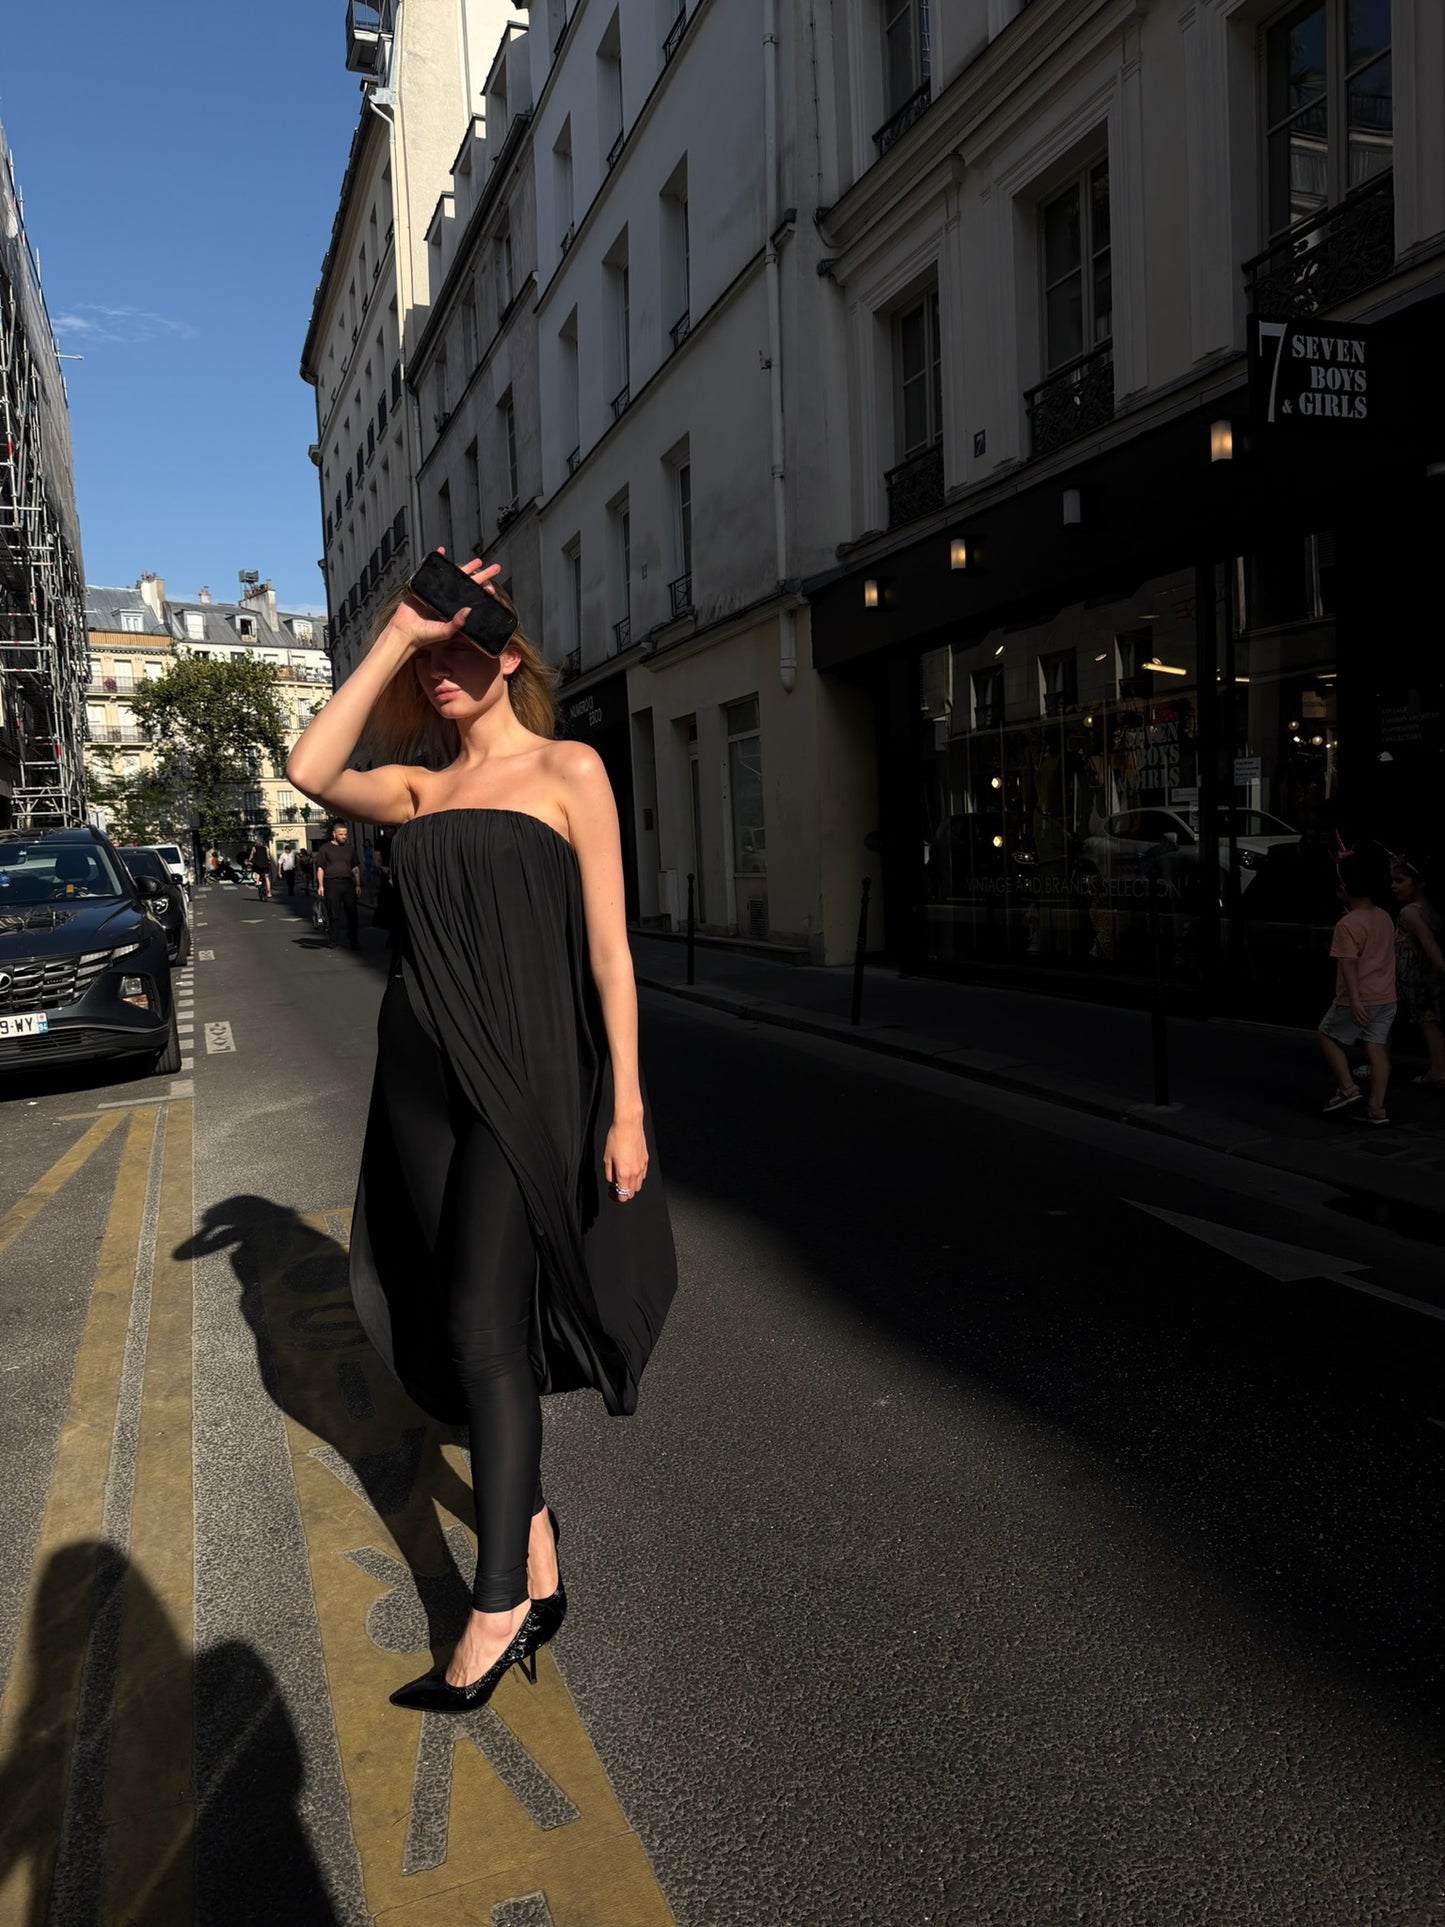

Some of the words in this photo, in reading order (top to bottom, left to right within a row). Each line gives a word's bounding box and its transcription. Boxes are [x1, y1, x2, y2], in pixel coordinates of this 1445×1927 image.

[1292, 334, 1366, 363] SEVEN
[1258, 320, 1288, 422] 7
[1310, 365, 1367, 392] BOYS
[1281, 399, 1293, 414] &
[1299, 392, 1367, 419] GIRLS
[1135, 743, 1180, 770] BOYS
[966, 876, 1012, 894] VINTAGE
[1015, 876, 1042, 894] AND
[1102, 878, 1182, 898] SELECTON
